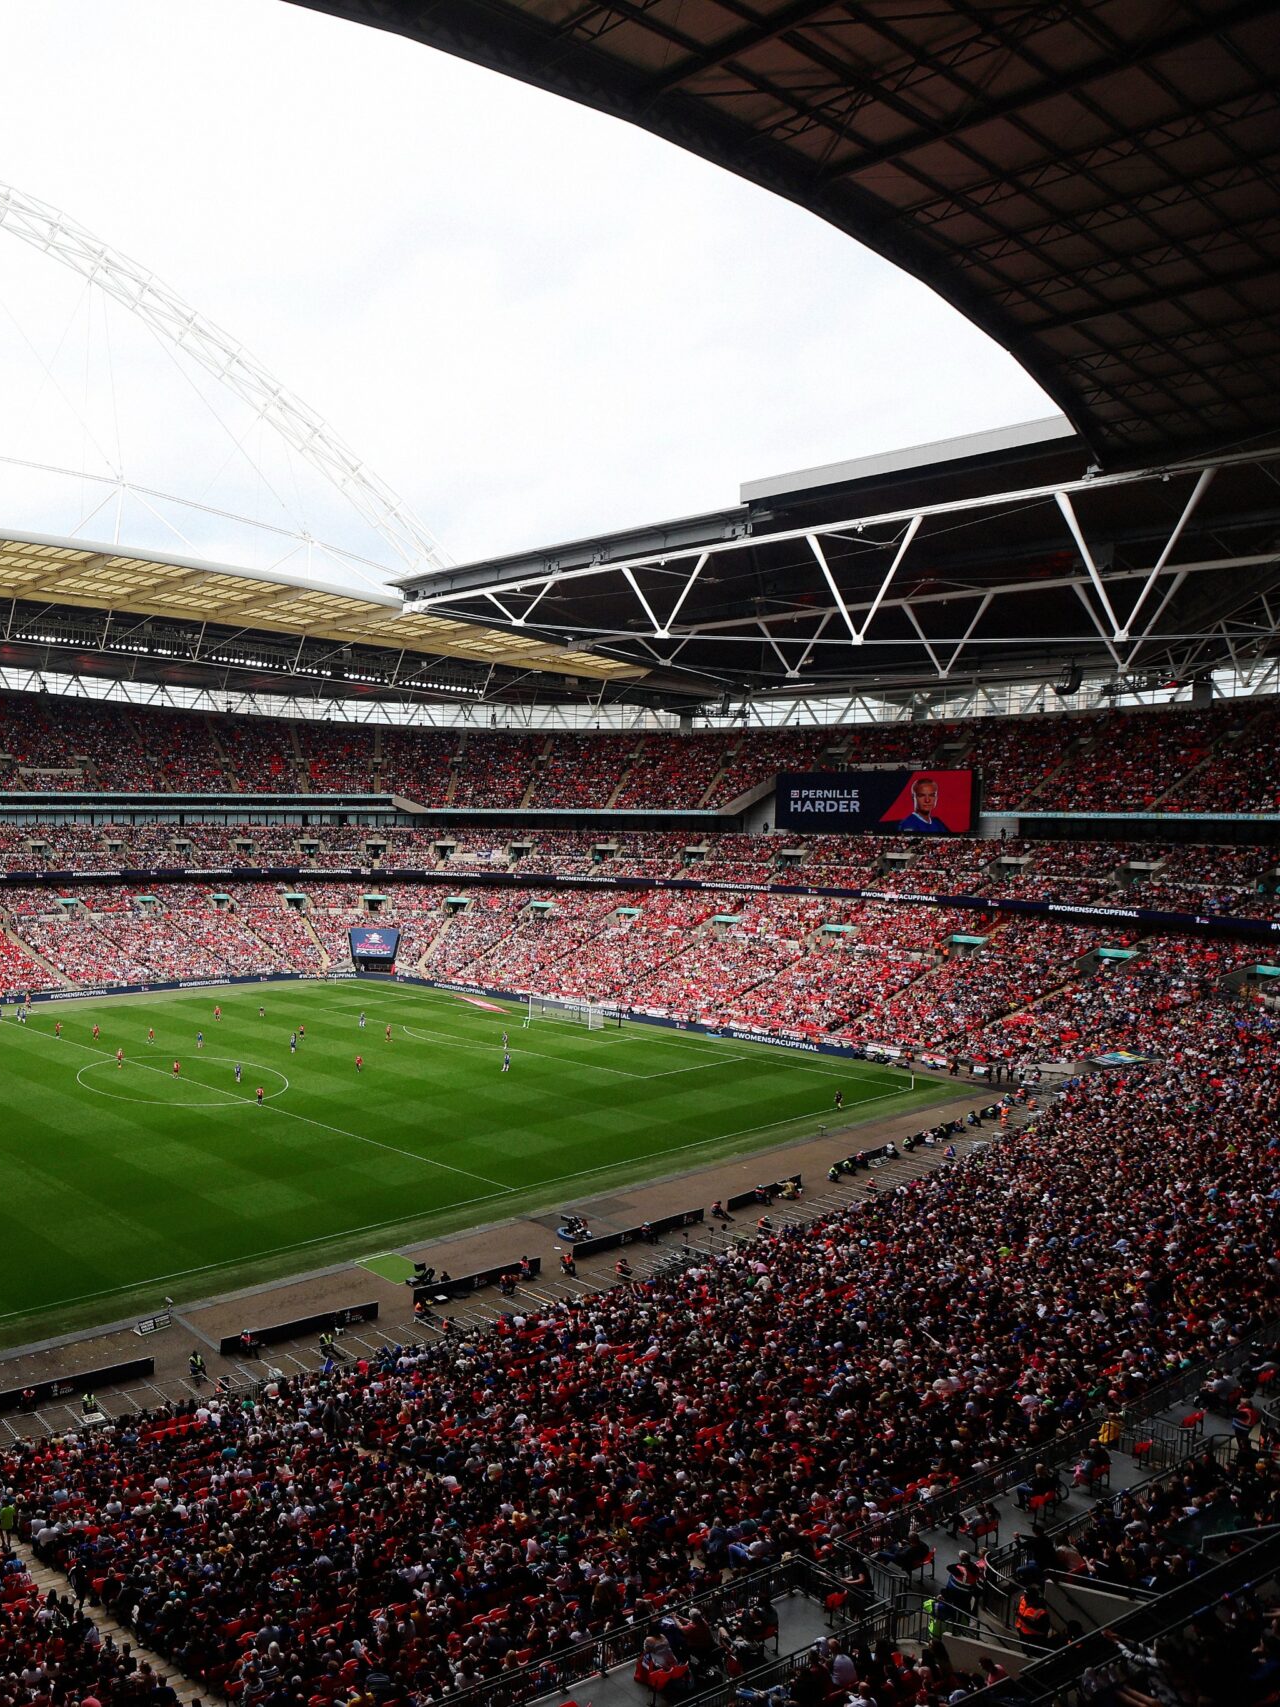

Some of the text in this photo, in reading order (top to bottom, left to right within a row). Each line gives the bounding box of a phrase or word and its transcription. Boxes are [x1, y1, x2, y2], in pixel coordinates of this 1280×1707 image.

[802, 790, 859, 799] PERNILLE
[790, 800, 860, 813] HARDER
[556, 875, 617, 883] #WOMENSFACUPFINAL
[1048, 905, 1139, 918] #WOMENSFACUPFINAL
[179, 979, 231, 987] #WOMENSFACUPFINAL
[51, 989, 107, 998] #WOMENSFACUPFINAL
[434, 983, 486, 995] #WOMENSFACUPFINAL
[732, 1031, 819, 1051] #WOMENSFACUPFINAL
